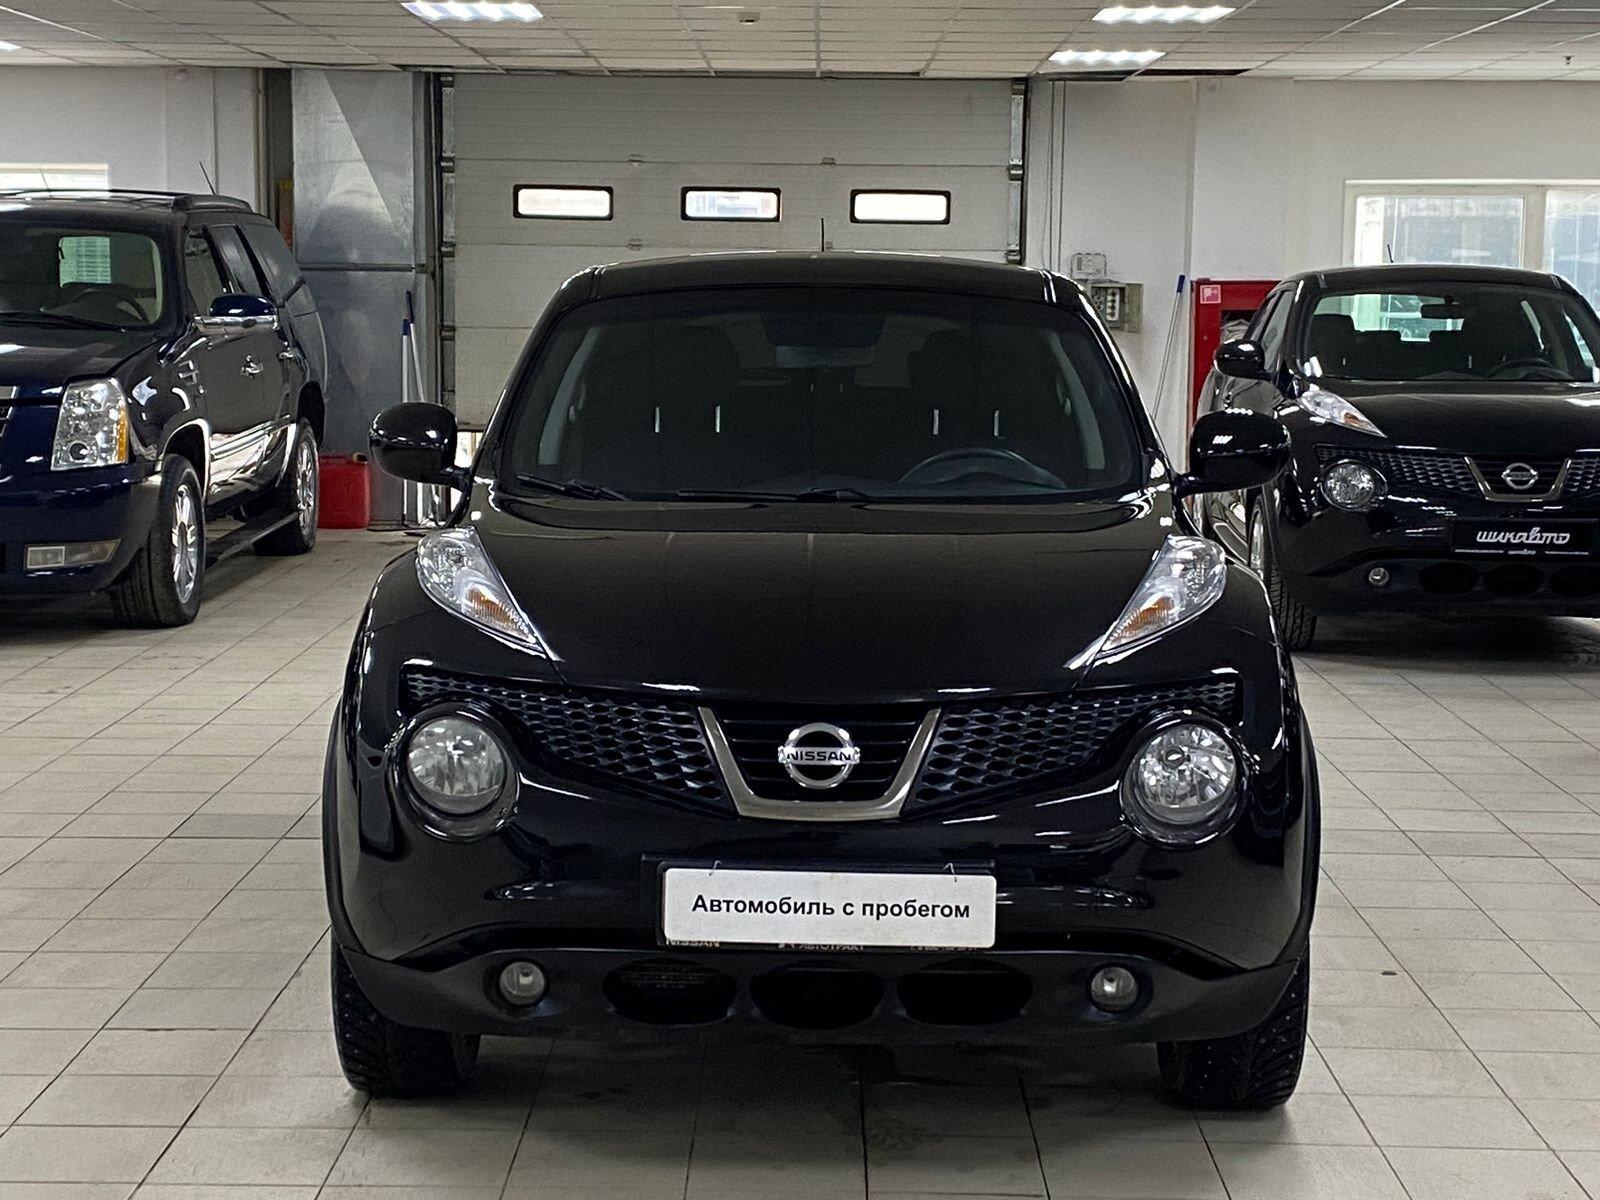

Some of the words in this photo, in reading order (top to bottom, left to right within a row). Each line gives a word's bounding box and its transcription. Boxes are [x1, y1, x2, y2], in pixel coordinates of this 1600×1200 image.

[786, 751, 851, 761] NISSAN
[691, 894, 835, 916] Автомобиль
[842, 902, 854, 916] с
[862, 899, 970, 921] пробегом
